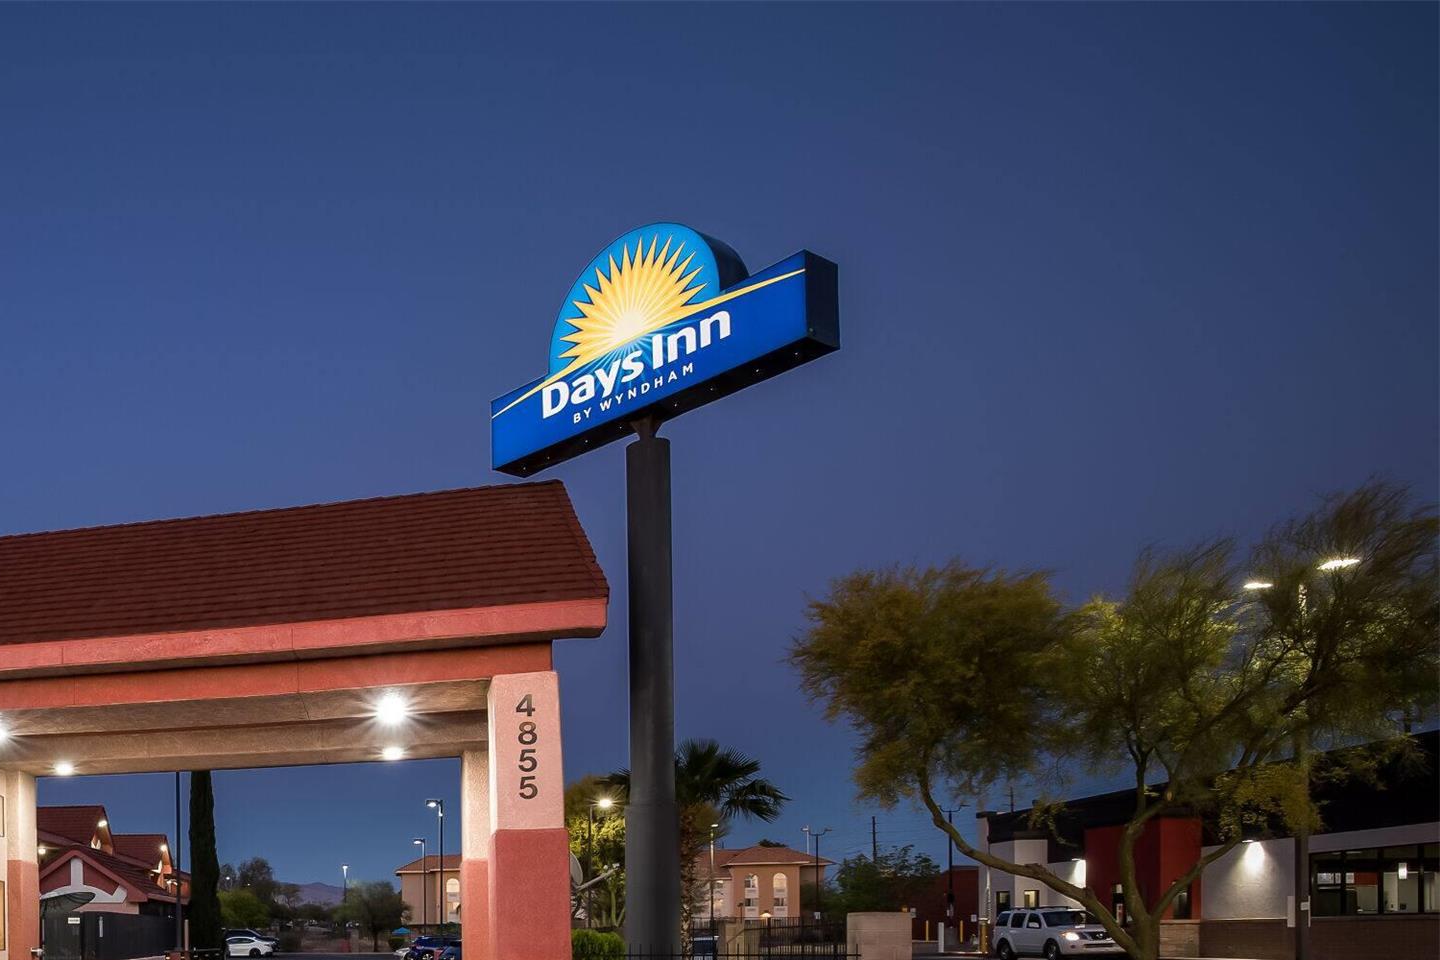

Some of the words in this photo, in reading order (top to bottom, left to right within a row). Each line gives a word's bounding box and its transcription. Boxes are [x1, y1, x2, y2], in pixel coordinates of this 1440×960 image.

[542, 350, 644, 419] Days
[652, 310, 731, 370] Inn
[573, 407, 592, 424] BY
[599, 362, 693, 412] WYNDHAM
[515, 693, 538, 800] 4855
